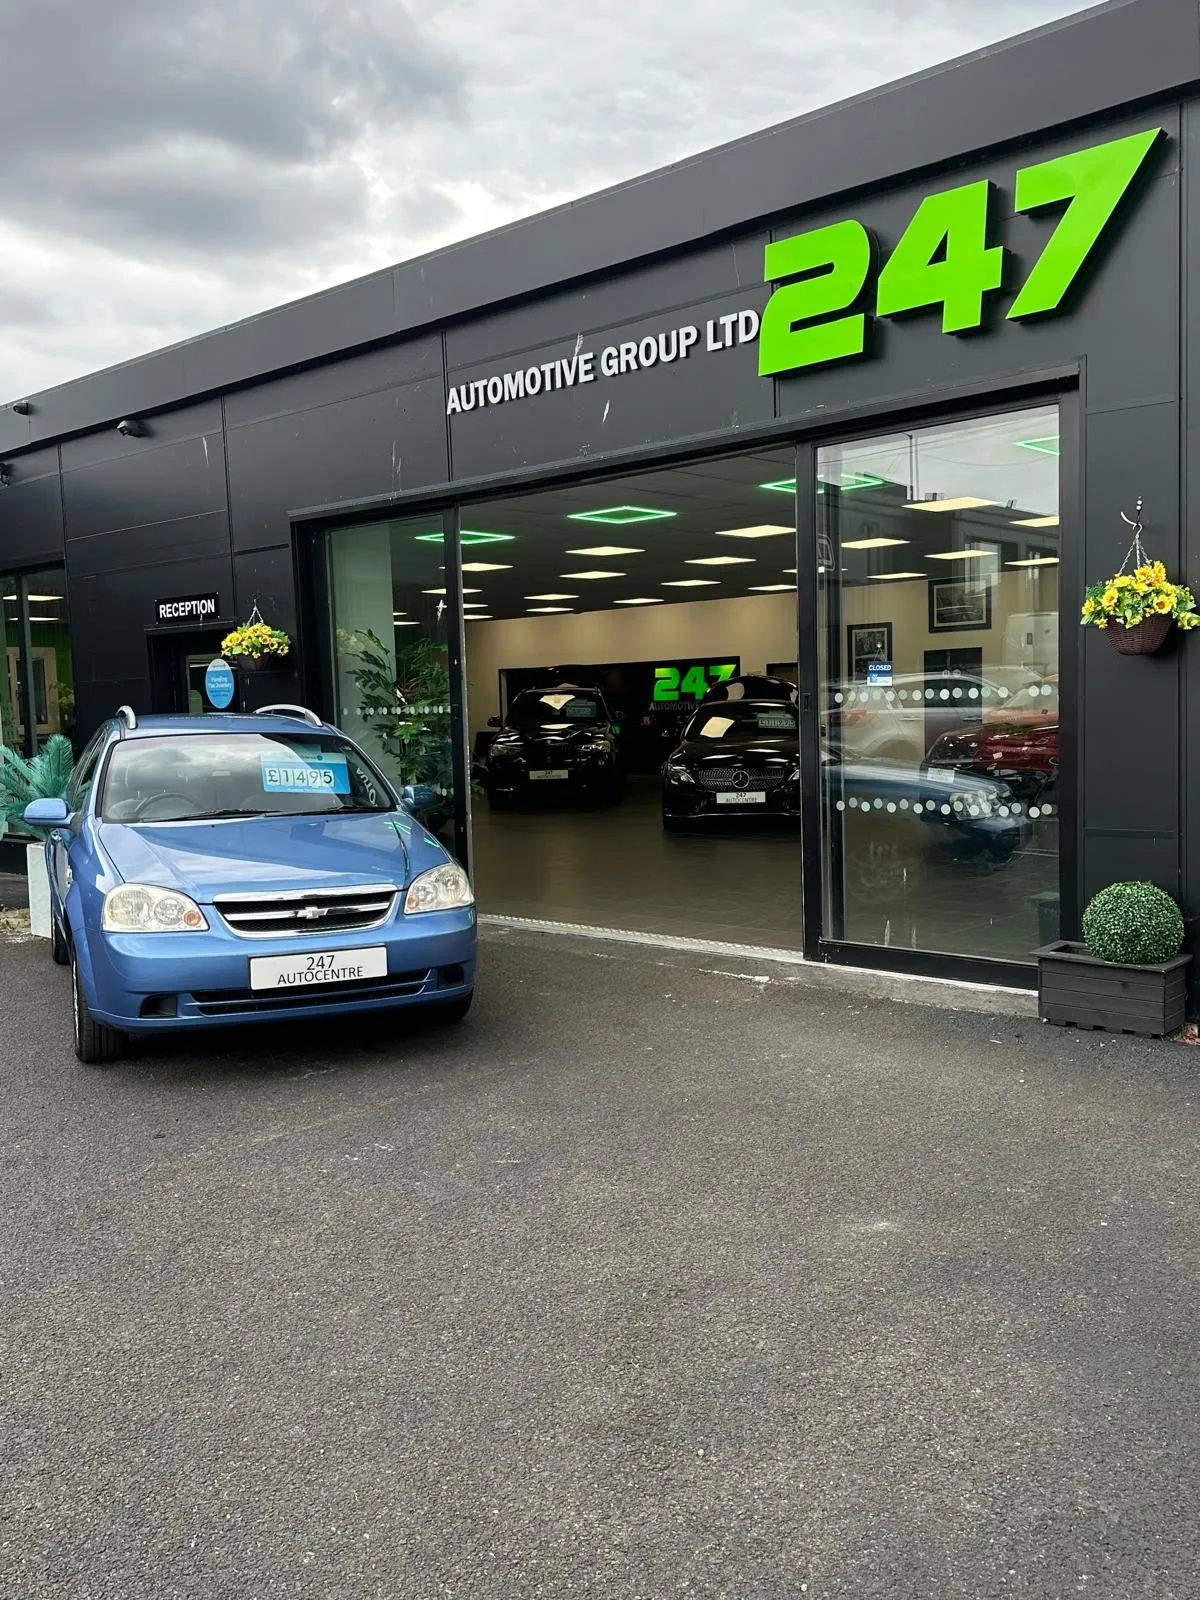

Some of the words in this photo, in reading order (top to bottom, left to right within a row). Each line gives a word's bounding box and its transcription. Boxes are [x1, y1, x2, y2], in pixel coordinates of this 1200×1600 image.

[758, 127, 1163, 377] 247
[446, 351, 595, 415] AUTOMOTIVE
[600, 325, 698, 377] GROUP
[706, 308, 760, 352] LTD
[159, 598, 216, 619] RECEPTION
[653, 664, 737, 701] 247
[267, 768, 333, 785] £1495
[306, 955, 335, 970] 247
[277, 966, 364, 985] AUTOCENTRE
